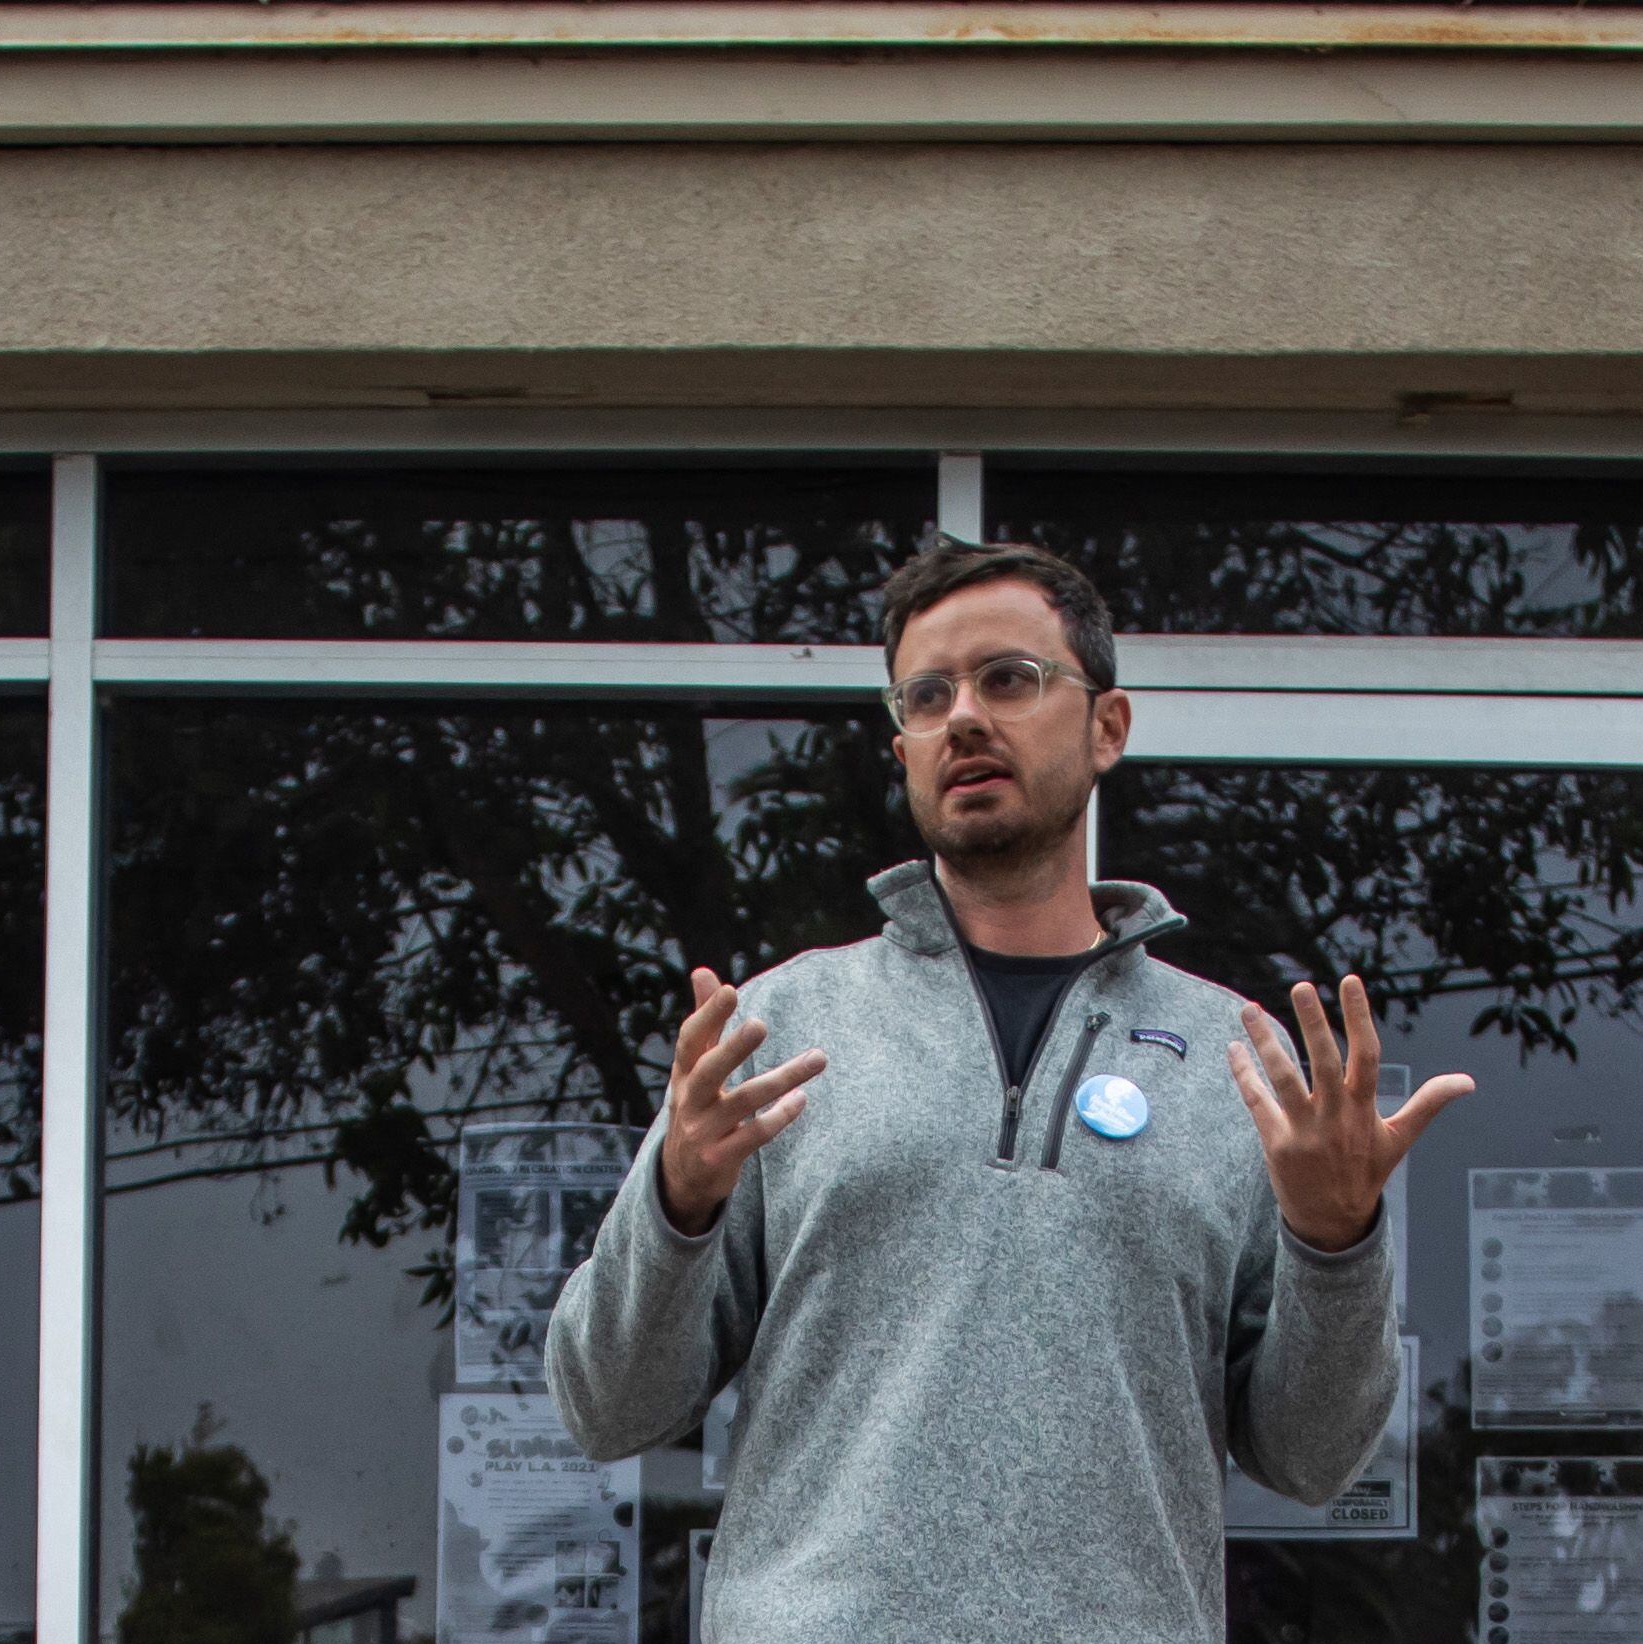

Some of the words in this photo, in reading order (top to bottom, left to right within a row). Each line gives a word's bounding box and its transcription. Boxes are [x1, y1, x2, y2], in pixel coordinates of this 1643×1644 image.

[484, 1461, 522, 1472] PLAY
[560, 1461, 597, 1473] 2021
[1331, 1508, 1389, 1520] CLOSED
